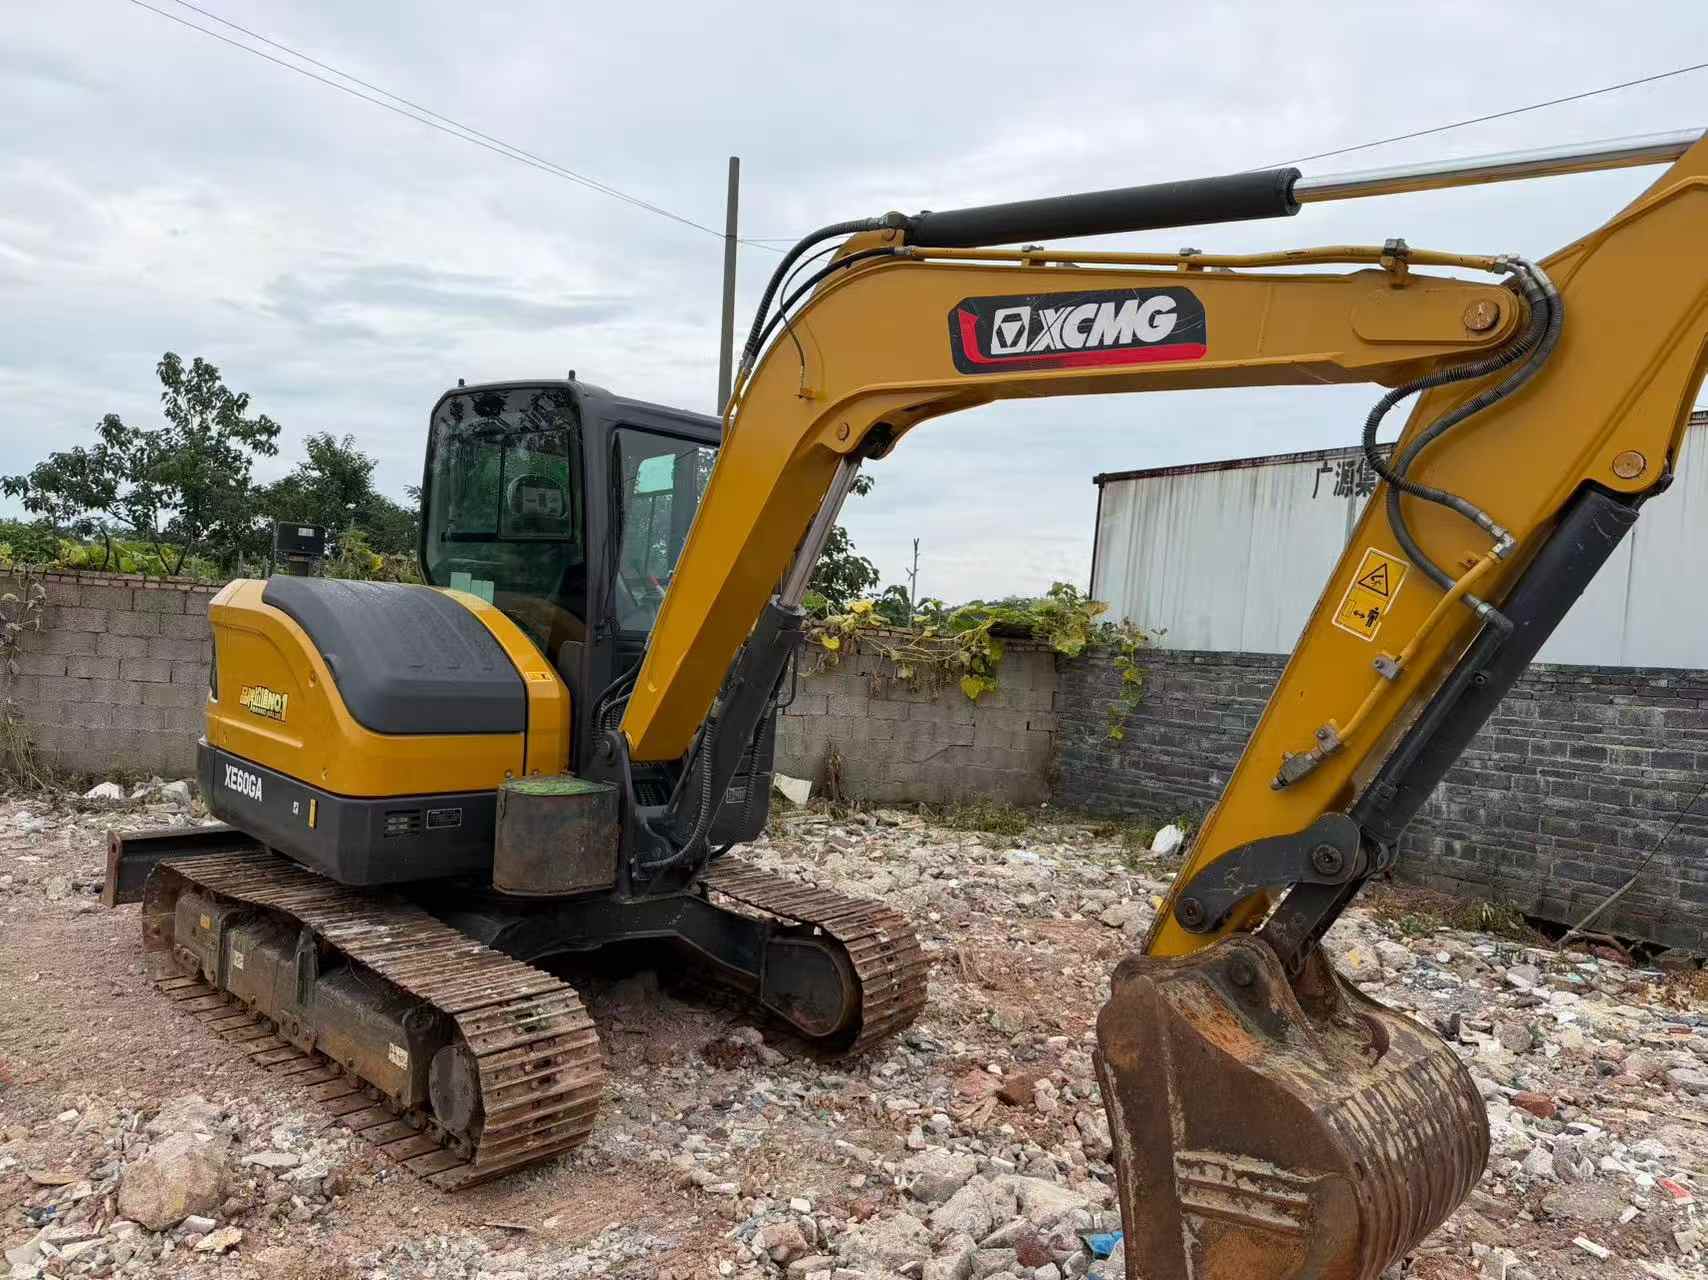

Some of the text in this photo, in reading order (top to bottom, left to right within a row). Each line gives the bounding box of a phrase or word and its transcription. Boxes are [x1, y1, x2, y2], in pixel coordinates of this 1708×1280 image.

[1025, 295, 1178, 352] XCMG
[1312, 457, 1391, 499] 广源集
[225, 763, 263, 802] XE60GA
